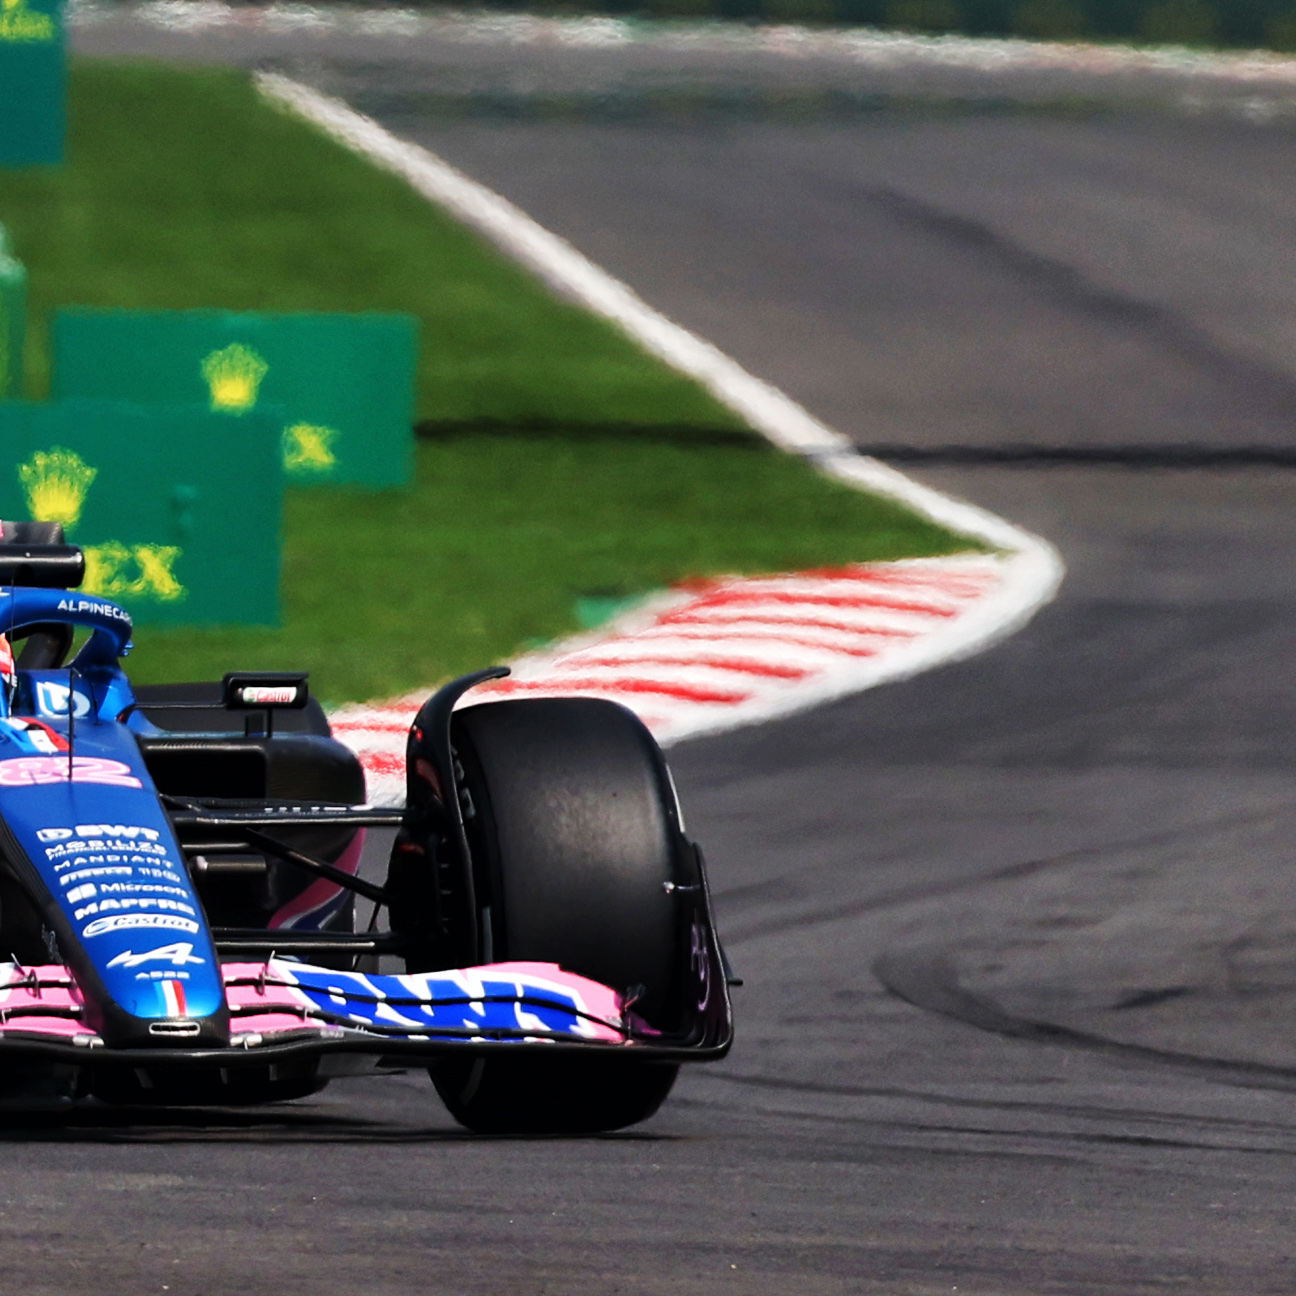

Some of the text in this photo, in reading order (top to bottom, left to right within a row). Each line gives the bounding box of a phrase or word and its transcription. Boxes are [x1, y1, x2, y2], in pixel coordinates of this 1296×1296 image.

[75, 824, 160, 841] BWT
[53, 854, 175, 872] MANDIANT
[100, 883, 189, 899] Microsoft
[74, 898, 196, 921] MAPFRE
[113, 915, 192, 930] Castrol
